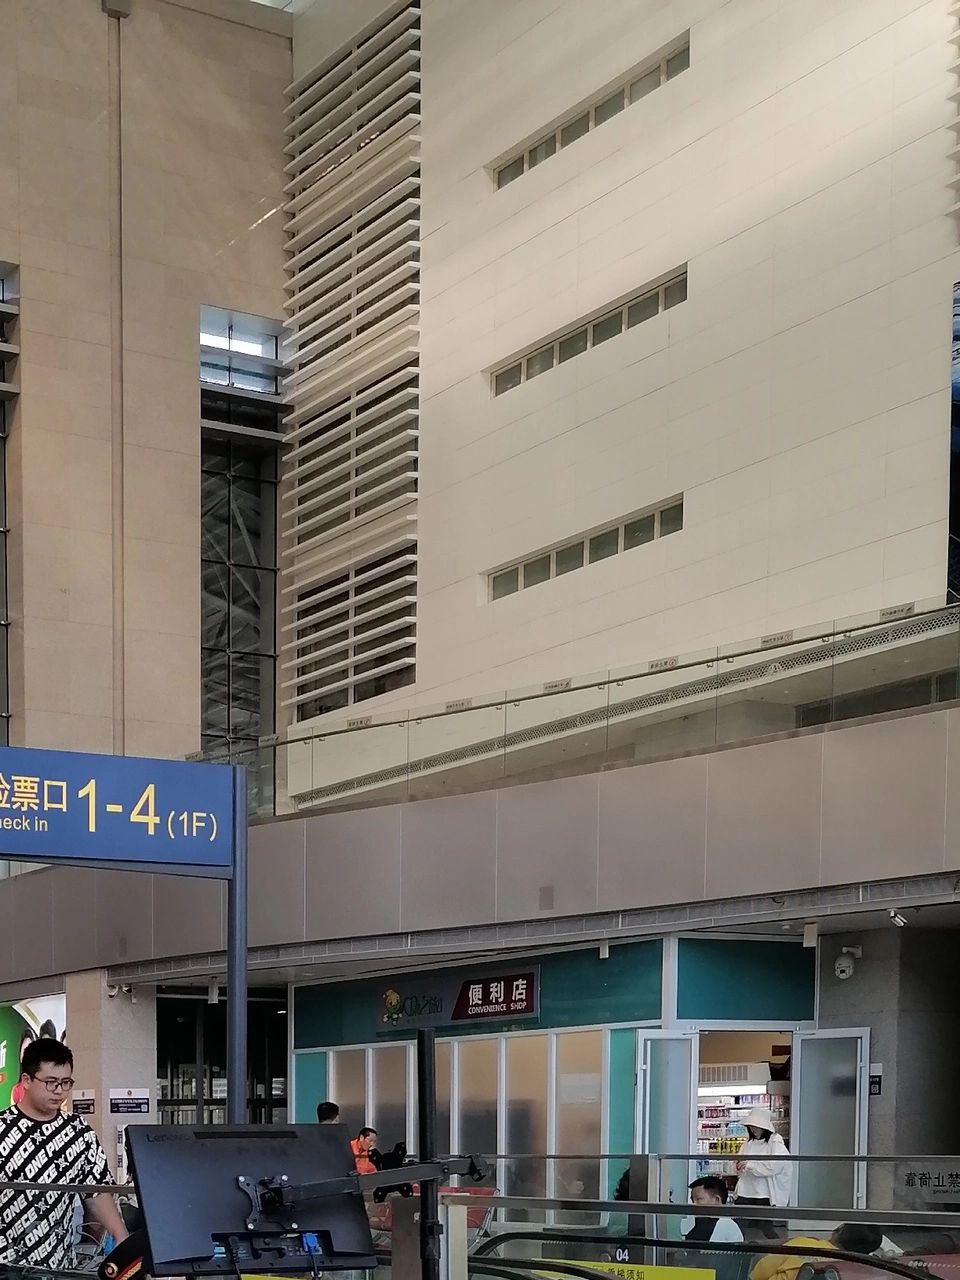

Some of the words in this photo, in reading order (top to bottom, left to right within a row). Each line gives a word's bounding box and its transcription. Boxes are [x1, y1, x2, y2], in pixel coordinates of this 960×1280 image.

[35, 814, 48, 832] in
[77, 778, 160, 836] 1-4
[167, 810, 218, 842] (1F)
[468, 978, 527, 1006] 便利店
[468, 1004, 507, 1015] CONVENIENCE
[0, 1127, 22, 1156] ONE
[24, 1148, 48, 1179] ONE
[46, 1125, 75, 1157] PIECE
[66, 1137, 86, 1162] ONE
[5, 1138, 35, 1177] PIECE
[3, 1194, 27, 1223] ONE
[6, 1207, 37, 1243] PIECE
[25, 1219, 49, 1247] ONE
[616, 1248, 630, 1262] 04
